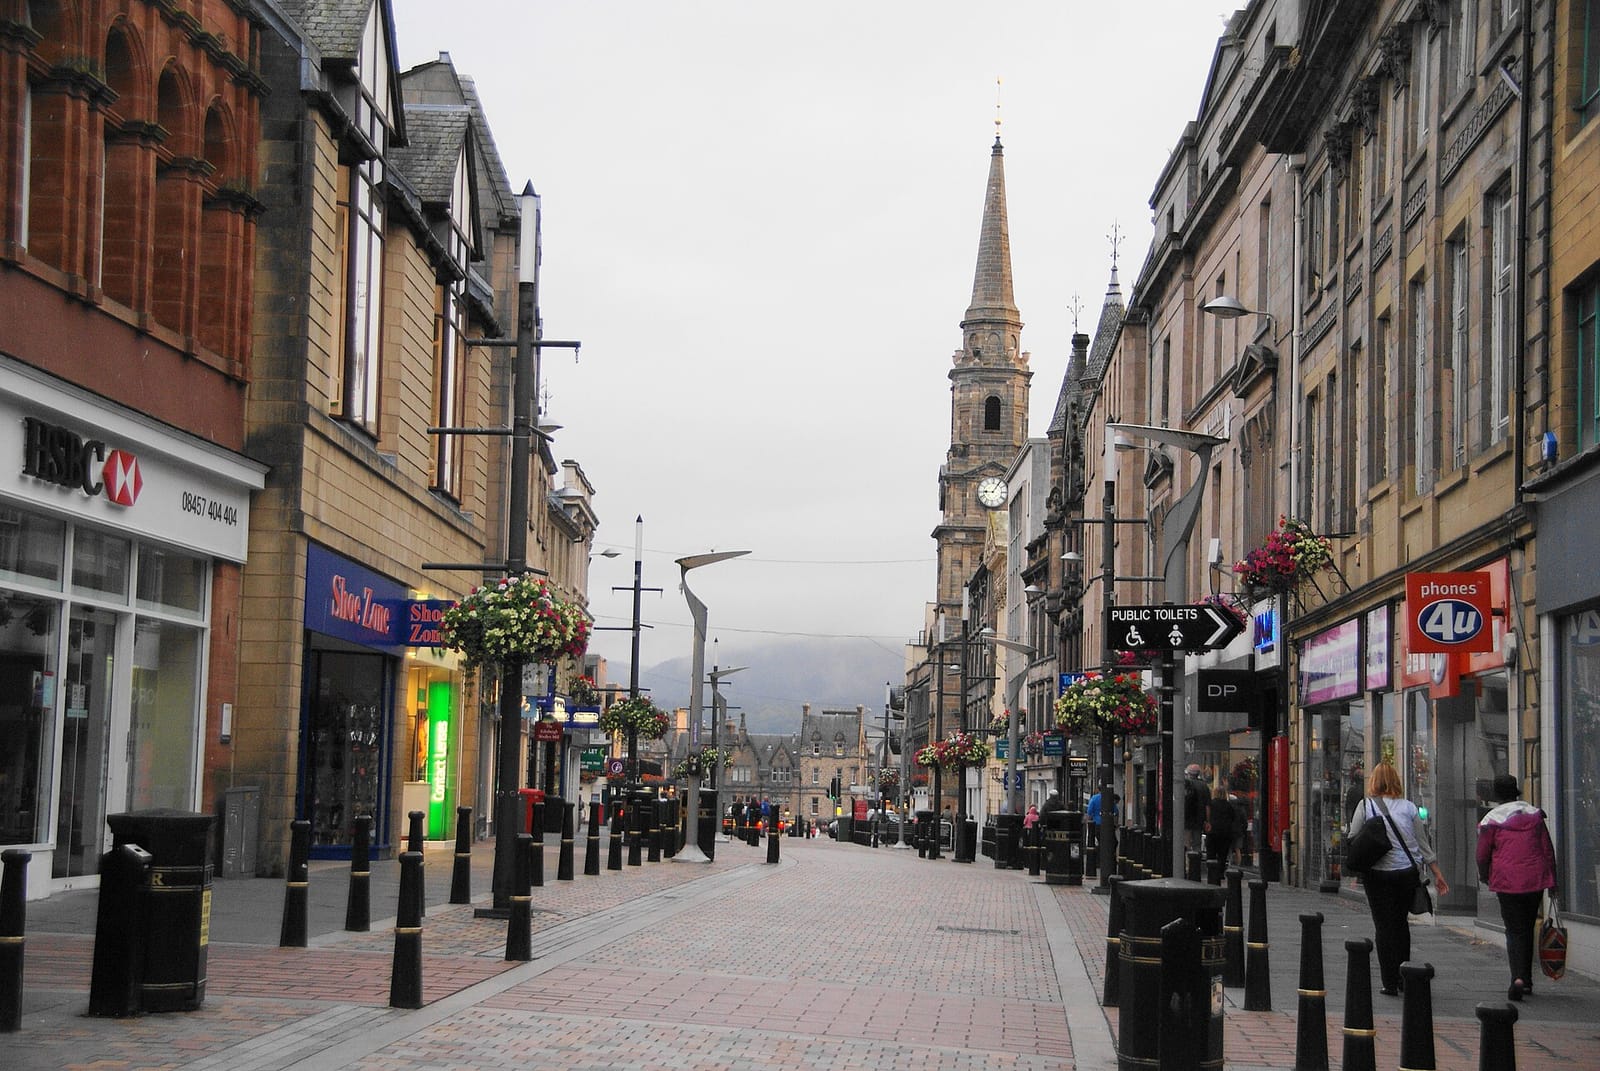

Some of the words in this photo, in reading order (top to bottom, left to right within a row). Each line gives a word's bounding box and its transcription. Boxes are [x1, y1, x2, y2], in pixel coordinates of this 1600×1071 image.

[22, 416, 105, 496] HSBC
[182, 490, 207, 517] 08457
[208, 499, 222, 523] 404
[224, 504, 238, 527] 404
[331, 574, 361, 623] Shoe
[362, 587, 391, 634] Zone
[1420, 581, 1477, 599] phones
[1111, 609, 1151, 621] PUBLIC
[1153, 608, 1198, 620] TOILETS
[1425, 602, 1477, 641] 4u
[1207, 684, 1238, 697] DP
[432, 759, 446, 801] Contact
